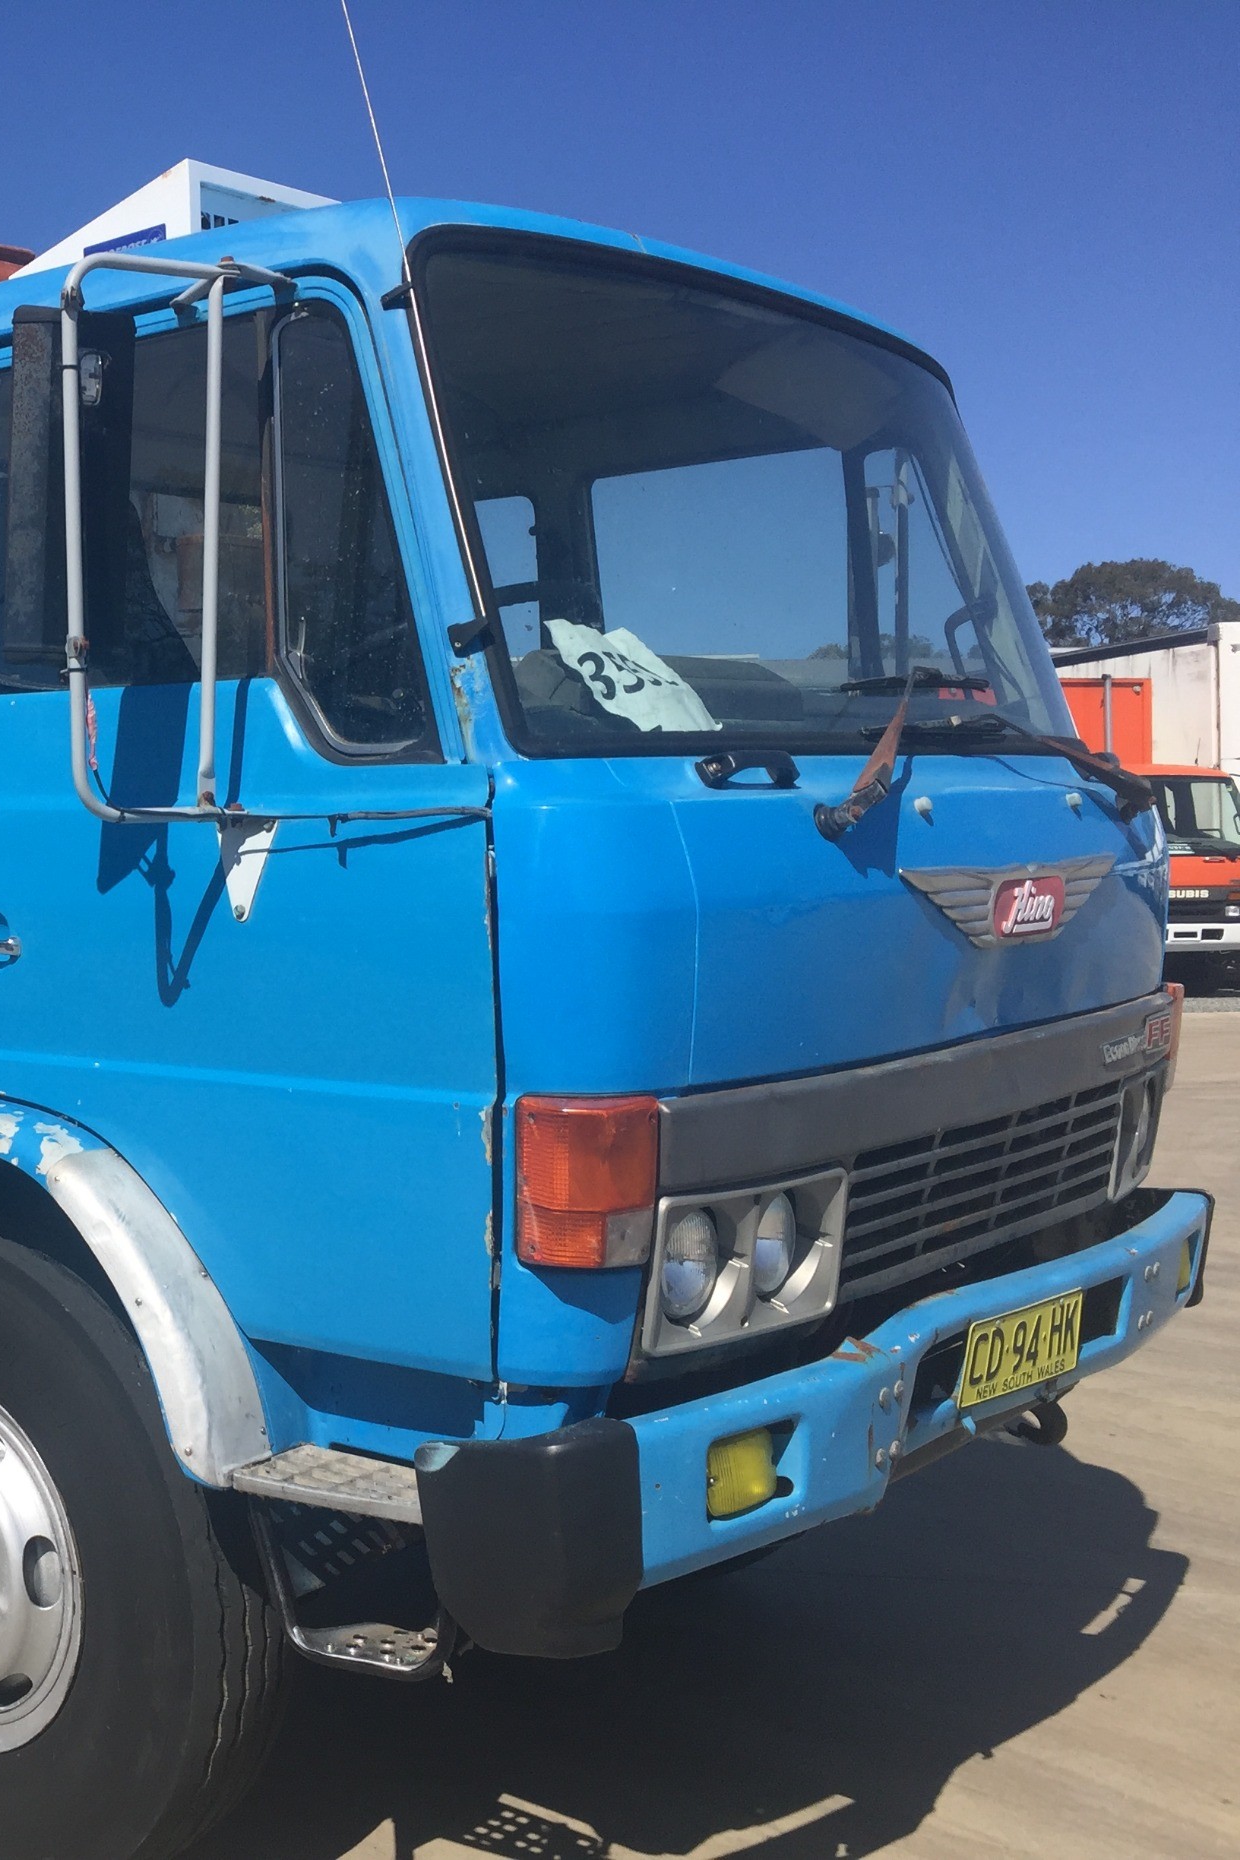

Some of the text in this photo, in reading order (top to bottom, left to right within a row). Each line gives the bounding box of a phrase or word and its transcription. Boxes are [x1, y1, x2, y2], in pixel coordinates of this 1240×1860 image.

[1001, 879, 1054, 934] Hino
[1168, 889, 1209, 899] SUBIS
[1146, 1015, 1170, 1050] FF
[975, 1358, 1066, 1400] NEW SOUTH WALES
